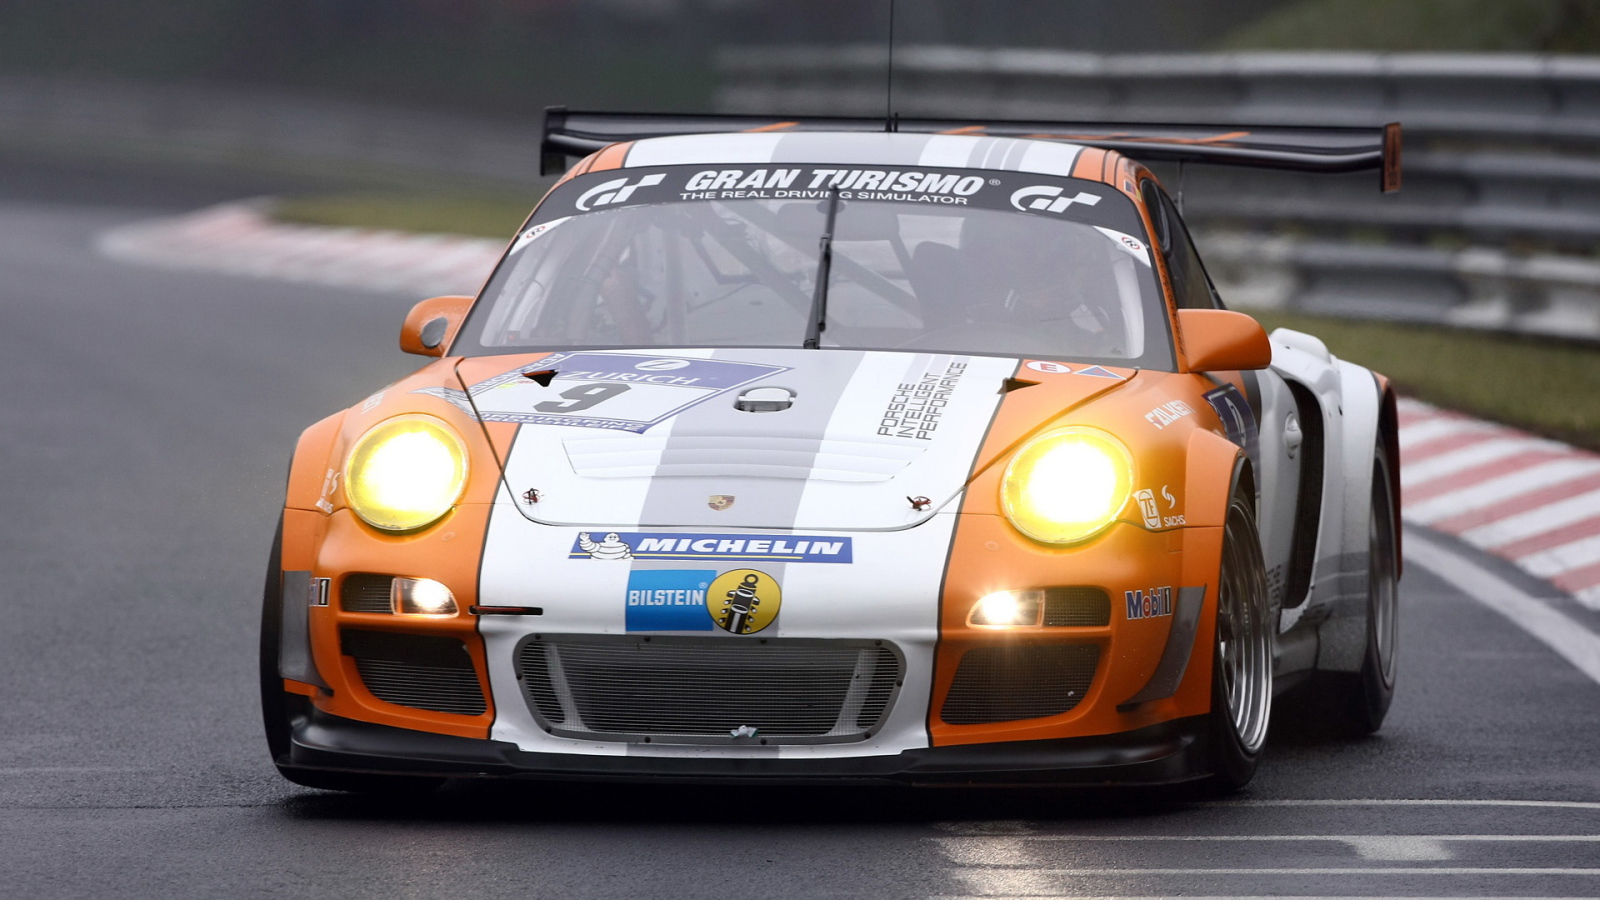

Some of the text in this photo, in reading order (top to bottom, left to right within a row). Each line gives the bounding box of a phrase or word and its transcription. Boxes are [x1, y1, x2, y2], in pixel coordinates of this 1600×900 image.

[684, 169, 985, 196] GRAN TURISMO
[679, 191, 716, 200] THE
[719, 190, 767, 199] REAL
[857, 191, 968, 205] SIMULATOR
[560, 371, 701, 385] ZURICH
[533, 382, 632, 412] 9
[896, 372, 941, 438] INTELLIGENT
[915, 362, 968, 440] PERFORMANCE
[877, 383, 915, 436] PORSCHE
[1164, 515, 1186, 527] SACHS
[636, 538, 844, 555] MICHELIN
[628, 589, 705, 606] BILSTEIN
